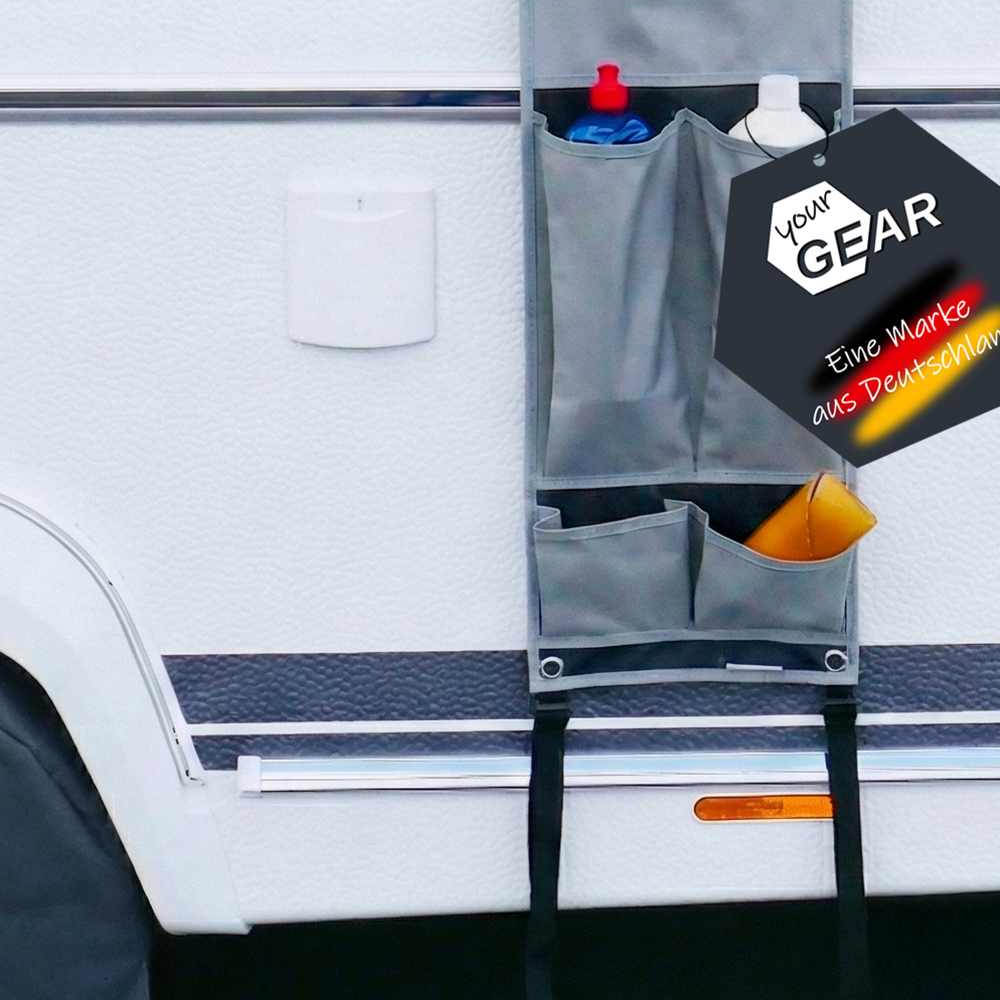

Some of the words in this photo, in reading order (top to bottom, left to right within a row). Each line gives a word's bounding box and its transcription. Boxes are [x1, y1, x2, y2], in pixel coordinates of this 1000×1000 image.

[775, 189, 832, 247] your
[796, 191, 943, 280] GEAR
[824, 338, 881, 374] Eine
[885, 297, 971, 348] Marke
[812, 392, 857, 426] aus
